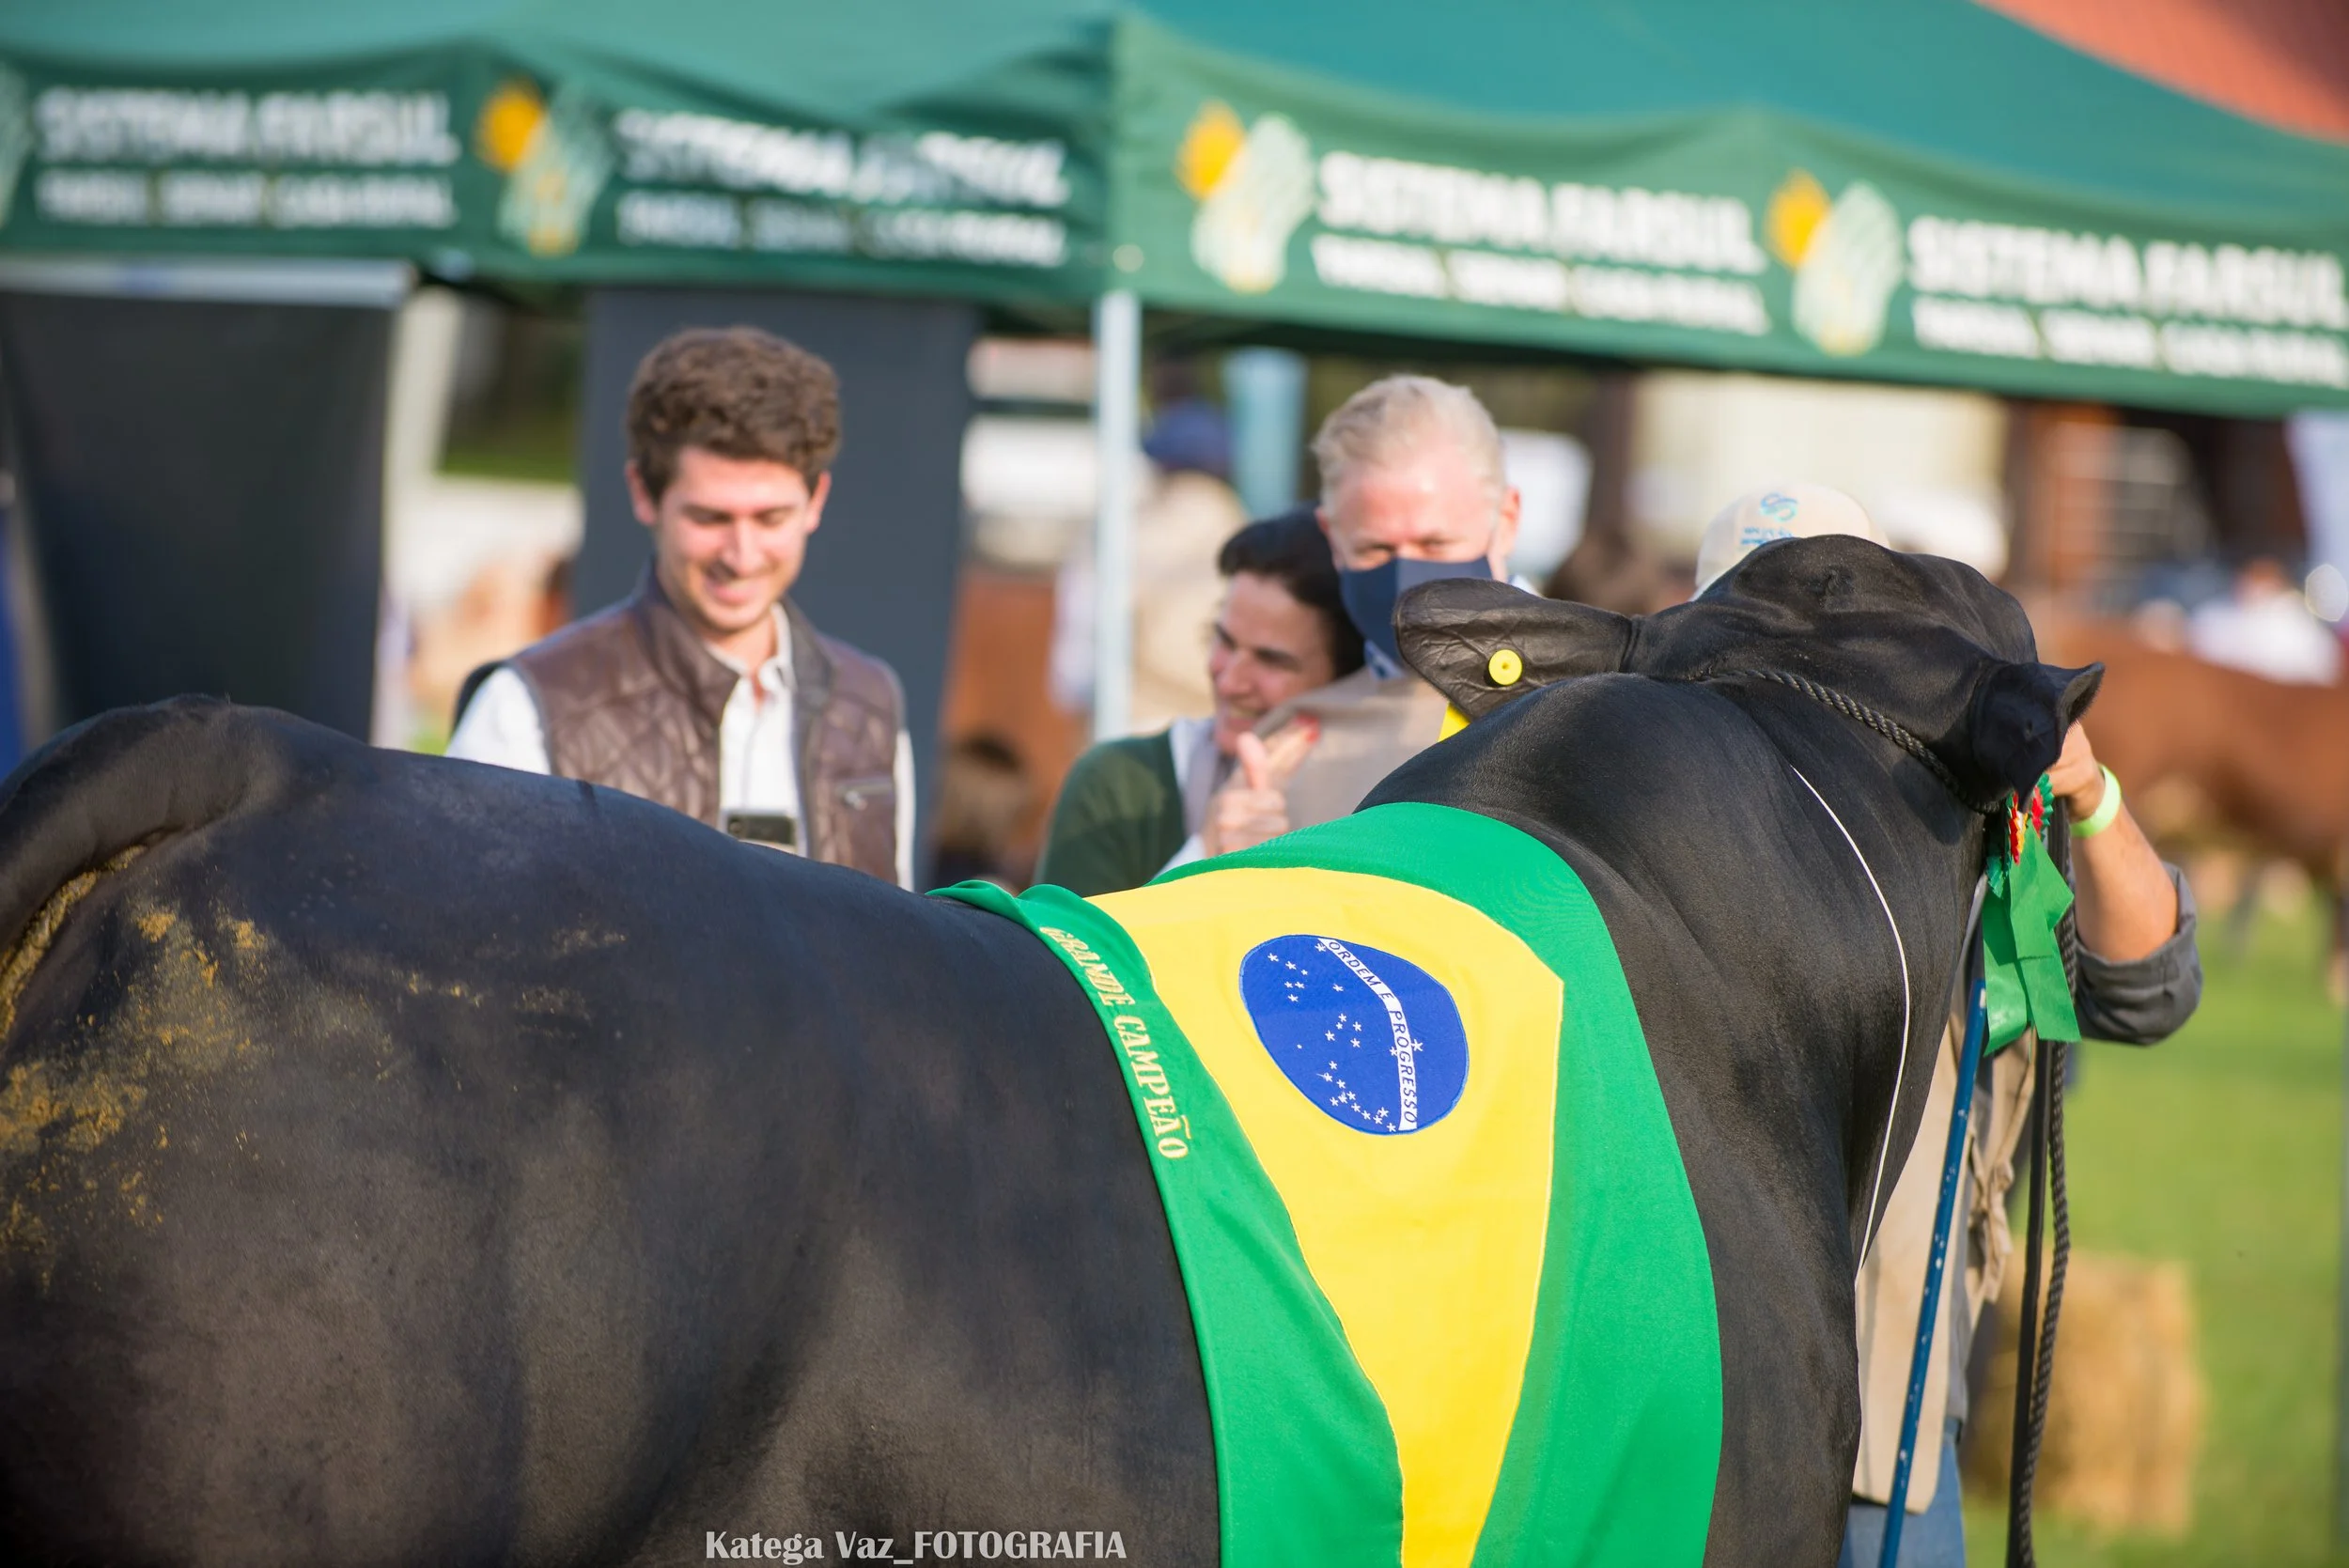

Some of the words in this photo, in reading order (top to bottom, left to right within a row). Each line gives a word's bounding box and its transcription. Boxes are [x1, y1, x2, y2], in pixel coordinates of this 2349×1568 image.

[1319, 151, 1548, 250] SISTEMA
[1550, 182, 1768, 274] FARSUL
[1908, 215, 2142, 308] SISTEMA
[2144, 241, 2349, 330] FARSUL
[1039, 926, 1136, 1006] GRANDE
[1113, 1015, 1192, 1159] CAMPEÃO
[1329, 940, 1382, 987] ORDEM
[1379, 991, 1394, 1001] E
[1389, 1010, 1417, 1124] PROGRESSO
